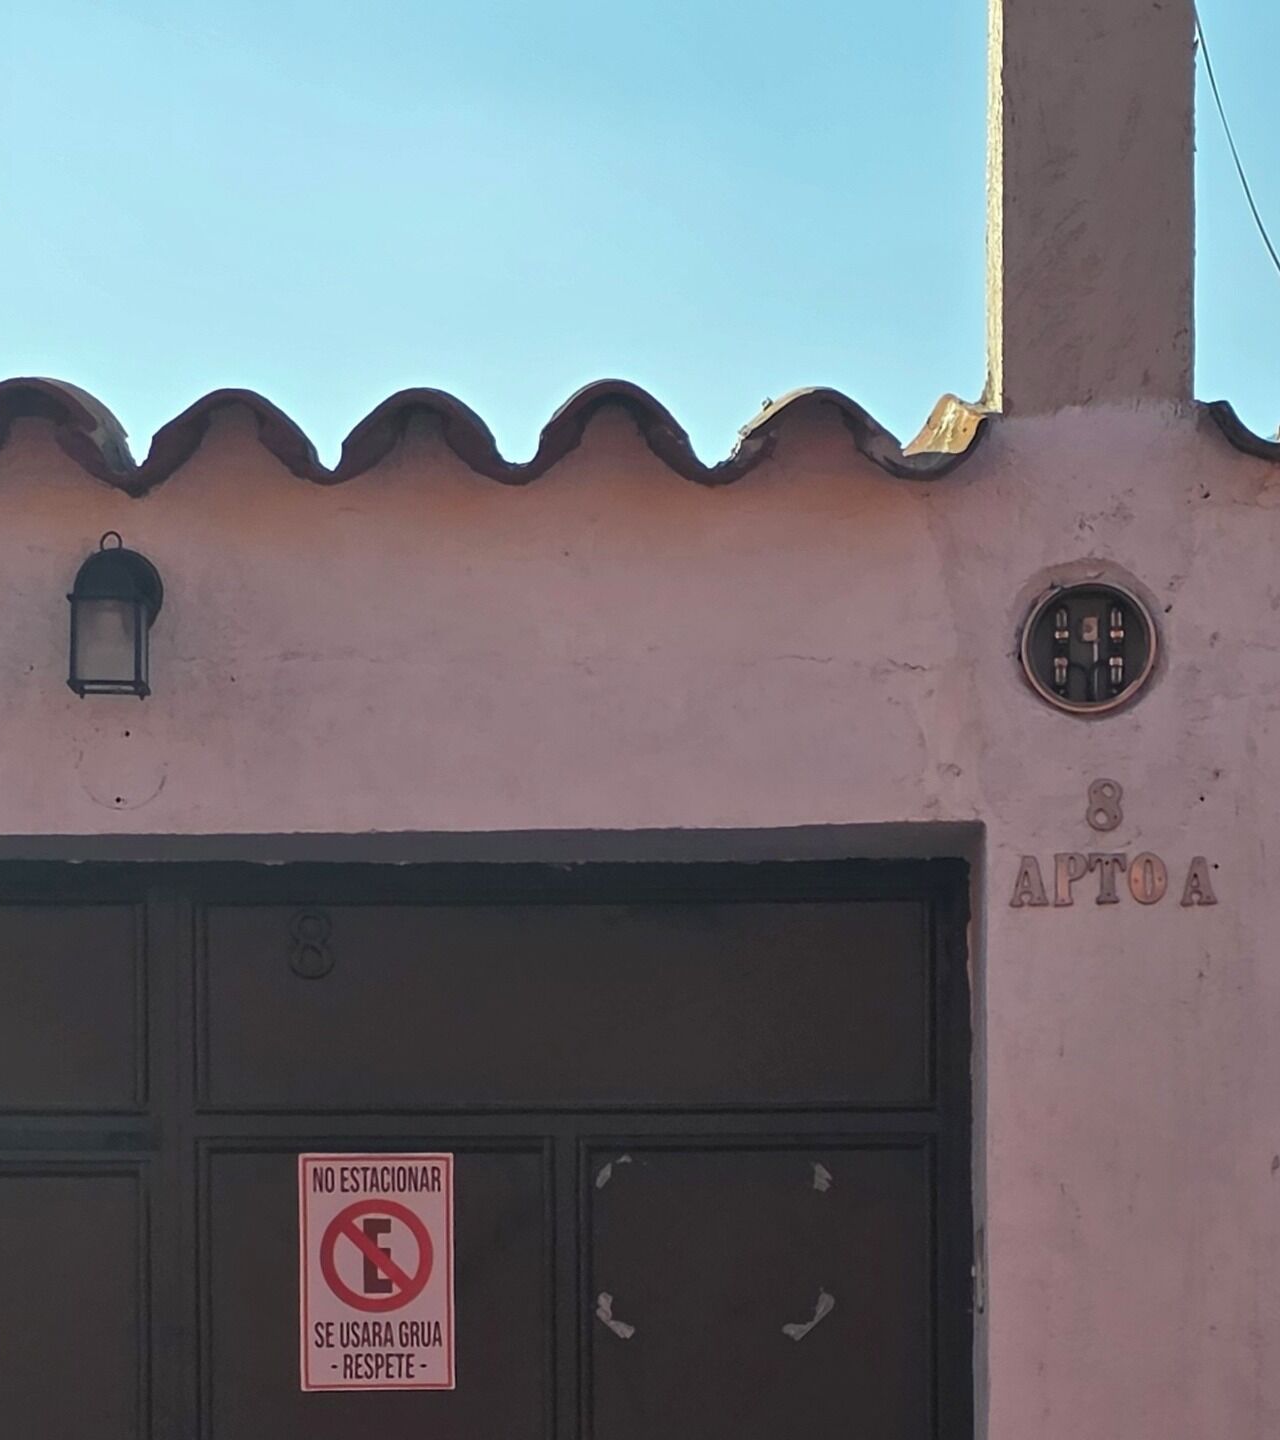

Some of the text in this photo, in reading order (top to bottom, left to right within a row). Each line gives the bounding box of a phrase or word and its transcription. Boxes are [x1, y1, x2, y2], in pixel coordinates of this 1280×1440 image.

[1086, 777, 1123, 832] 8
[1008, 851, 1218, 908] APTO A
[289, 908, 337, 980] 8
[312, 1166, 442, 1193] NO ESTACIONAR
[314, 1320, 443, 1348] SE USARA GRUA
